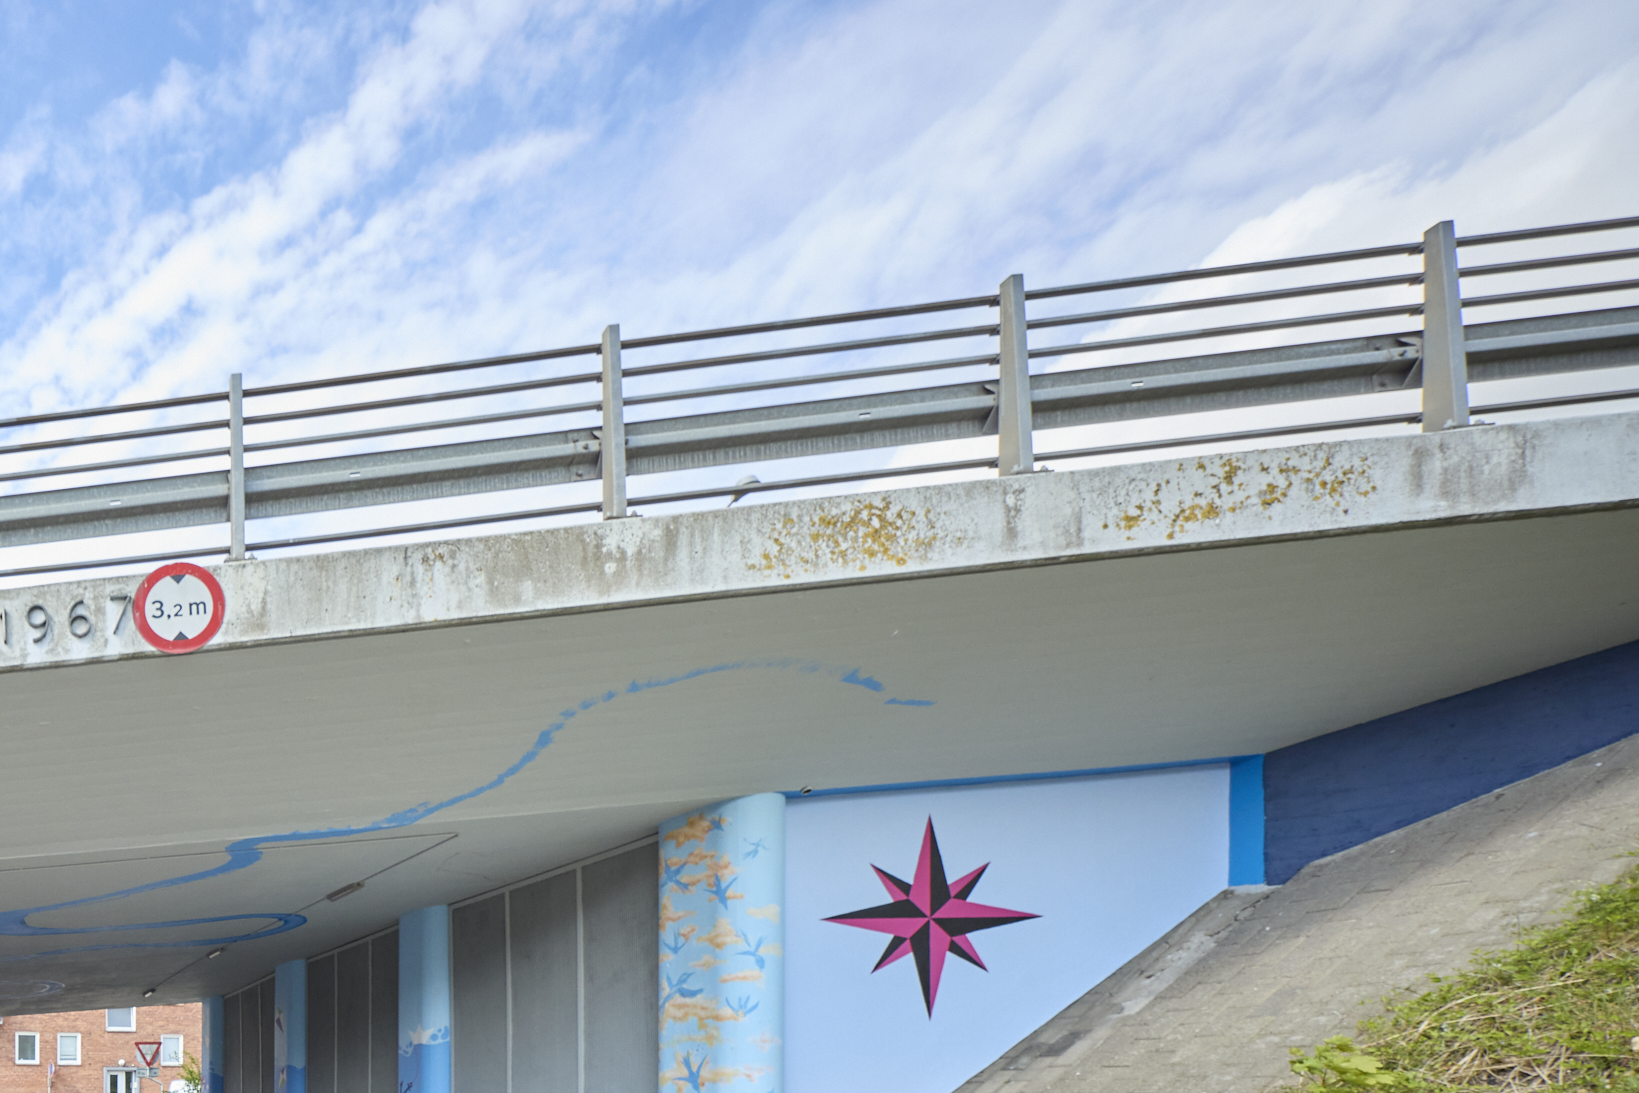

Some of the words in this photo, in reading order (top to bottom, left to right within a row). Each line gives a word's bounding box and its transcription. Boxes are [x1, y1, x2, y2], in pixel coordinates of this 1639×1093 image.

[0, 594, 132, 645] 1967
[151, 600, 183, 619] 3,2
[189, 601, 207, 616] m
